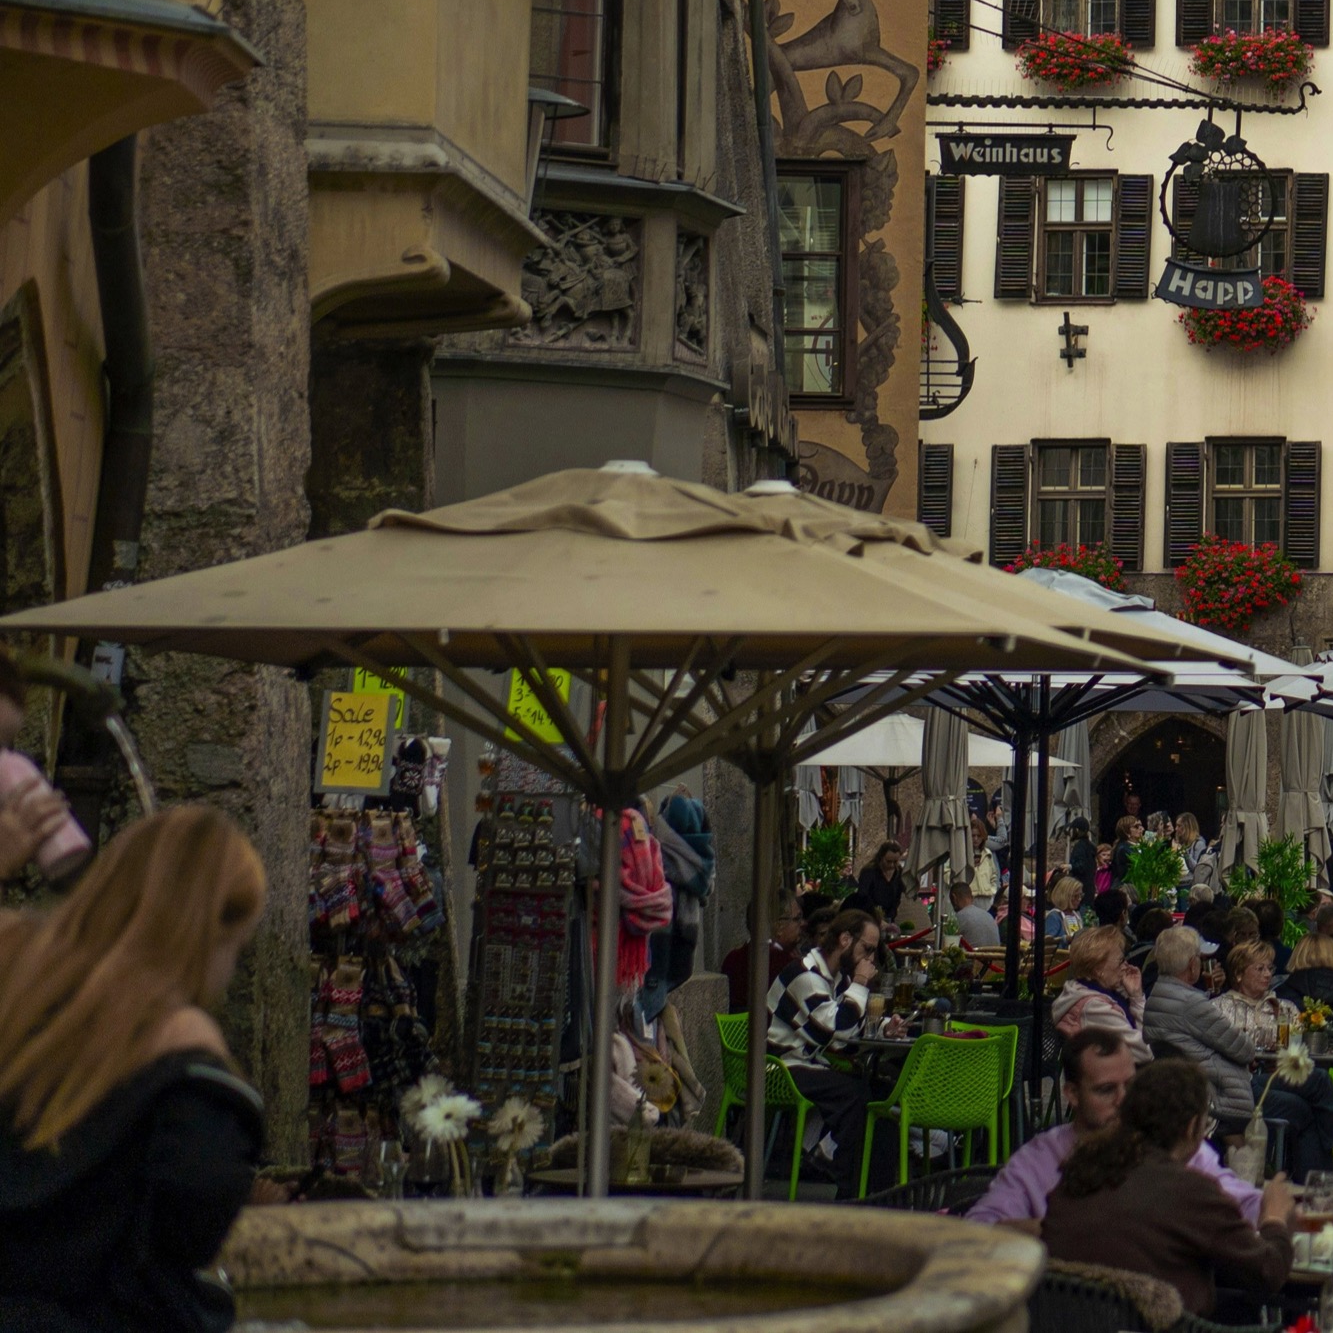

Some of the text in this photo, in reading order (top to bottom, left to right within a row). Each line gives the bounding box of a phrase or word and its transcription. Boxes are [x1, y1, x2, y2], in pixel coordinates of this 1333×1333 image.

[949, 138, 1063, 164] Weinhaus
[1168, 268, 1254, 305] Happ
[329, 698, 375, 724] Sale
